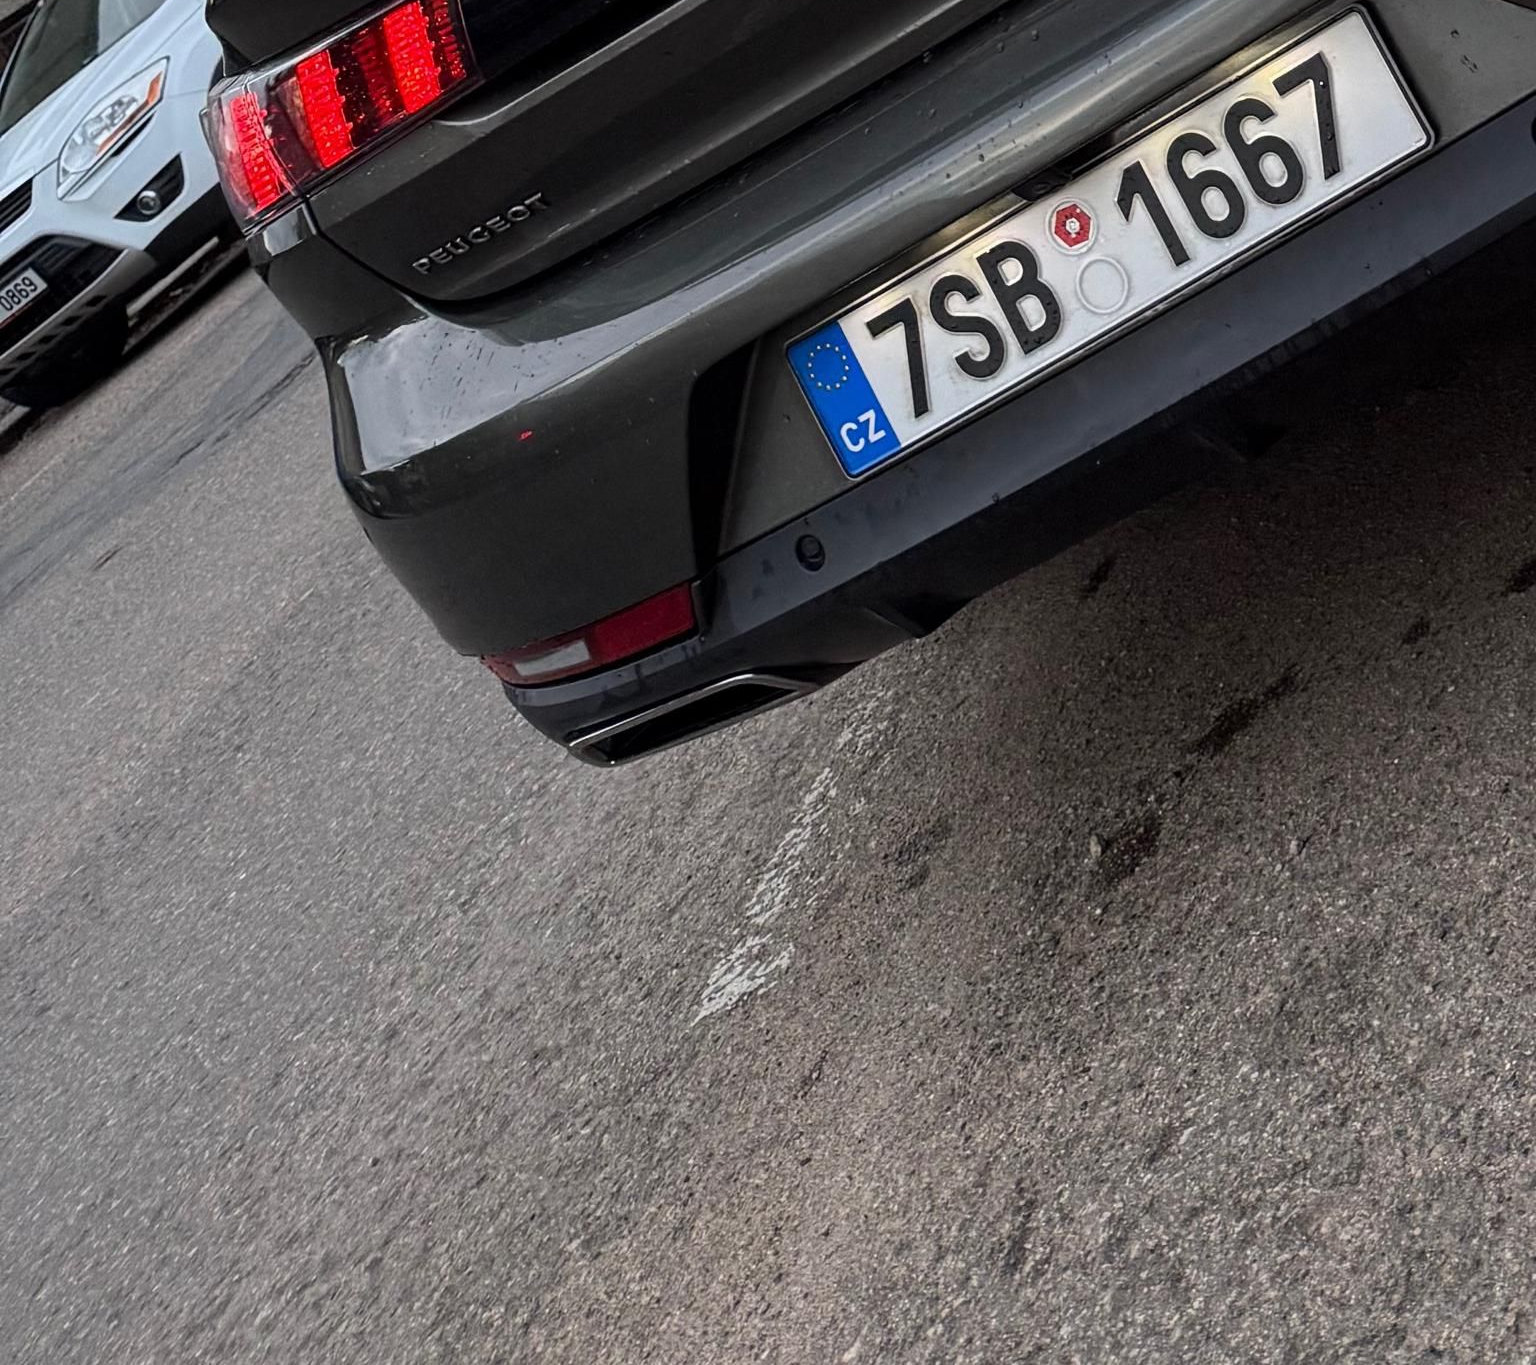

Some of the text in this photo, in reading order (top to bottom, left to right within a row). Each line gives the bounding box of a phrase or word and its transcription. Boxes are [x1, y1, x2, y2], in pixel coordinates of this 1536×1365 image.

[411, 191, 549, 275] PEUGEOT
[864, 51, 1342, 419] 7SB 1667
[0, 276, 38, 312] 0869
[839, 408, 887, 453] CZ
